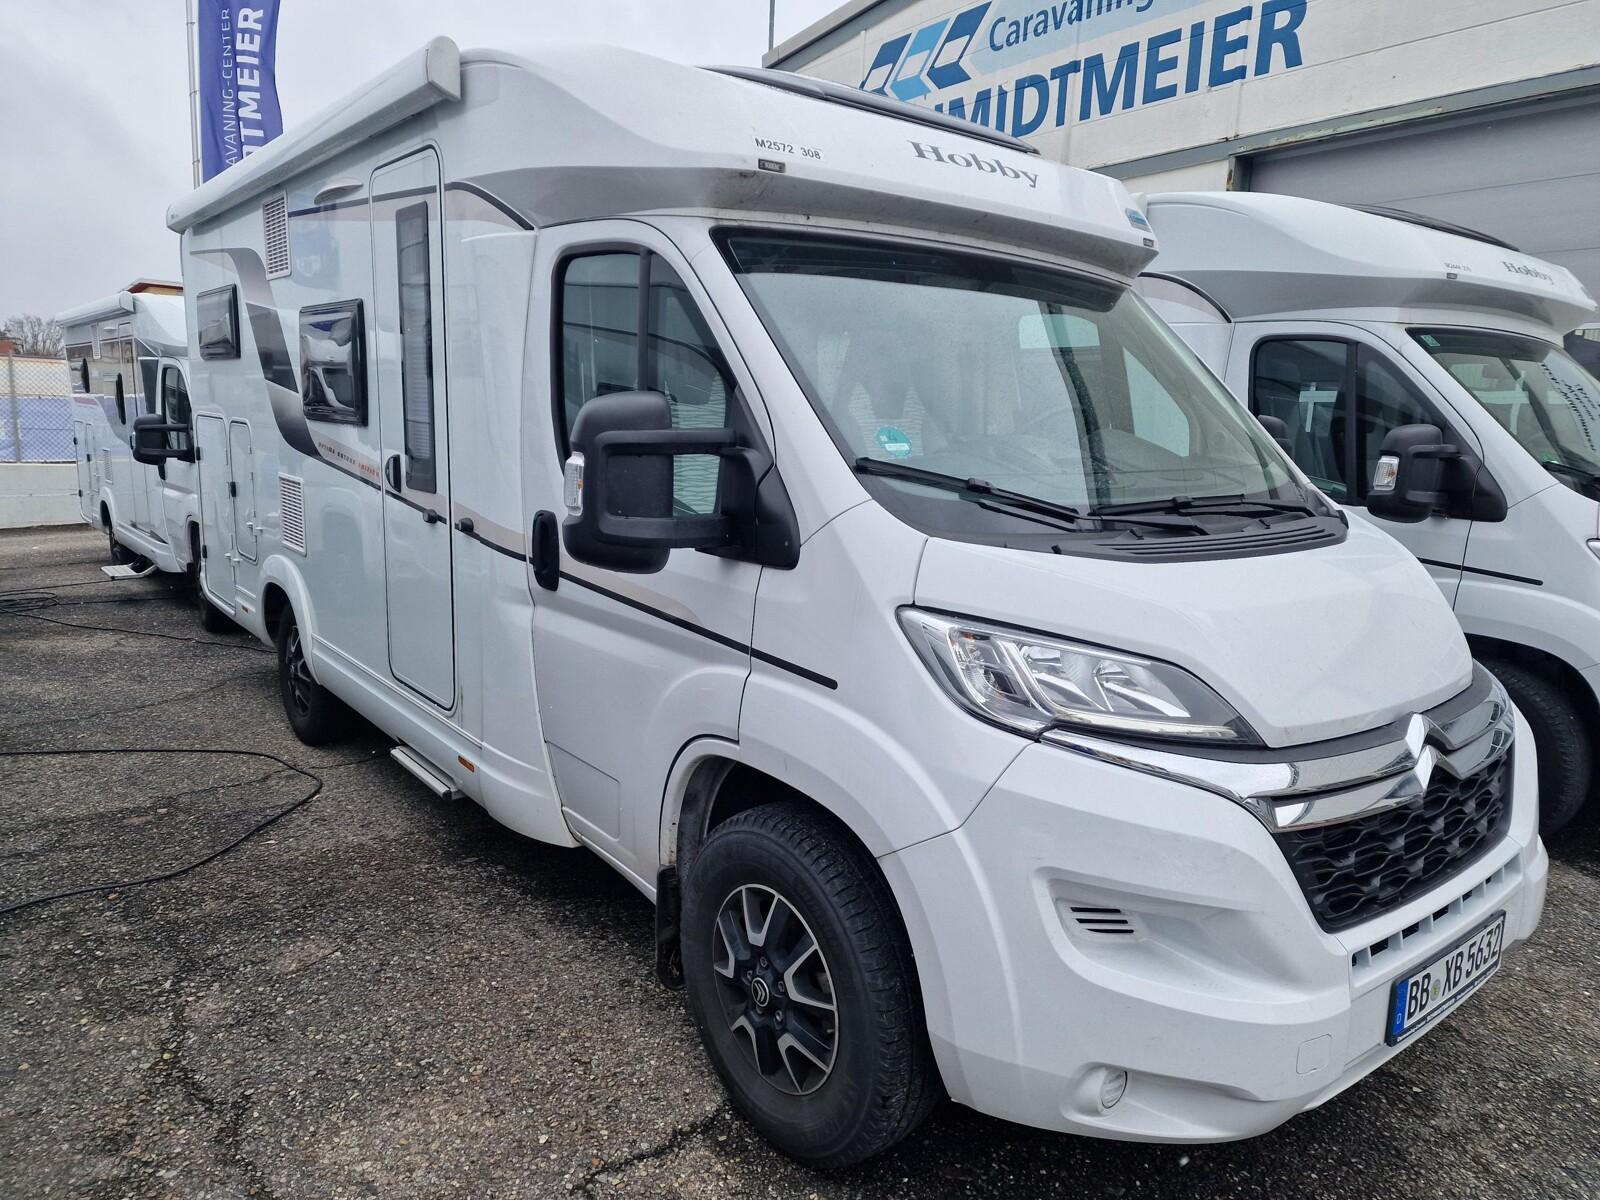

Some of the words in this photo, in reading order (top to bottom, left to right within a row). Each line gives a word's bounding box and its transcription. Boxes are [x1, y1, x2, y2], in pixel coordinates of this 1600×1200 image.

[935, 0, 1307, 138] IDTMEIER
[754, 138, 795, 154] M2572
[800, 147, 821, 160] 308
[908, 141, 1040, 189] Hobby
[1502, 261, 1555, 286] Hobby
[1406, 972, 1432, 1021] BB
[1442, 950, 1464, 997] XB
[1465, 922, 1501, 979] 5632
